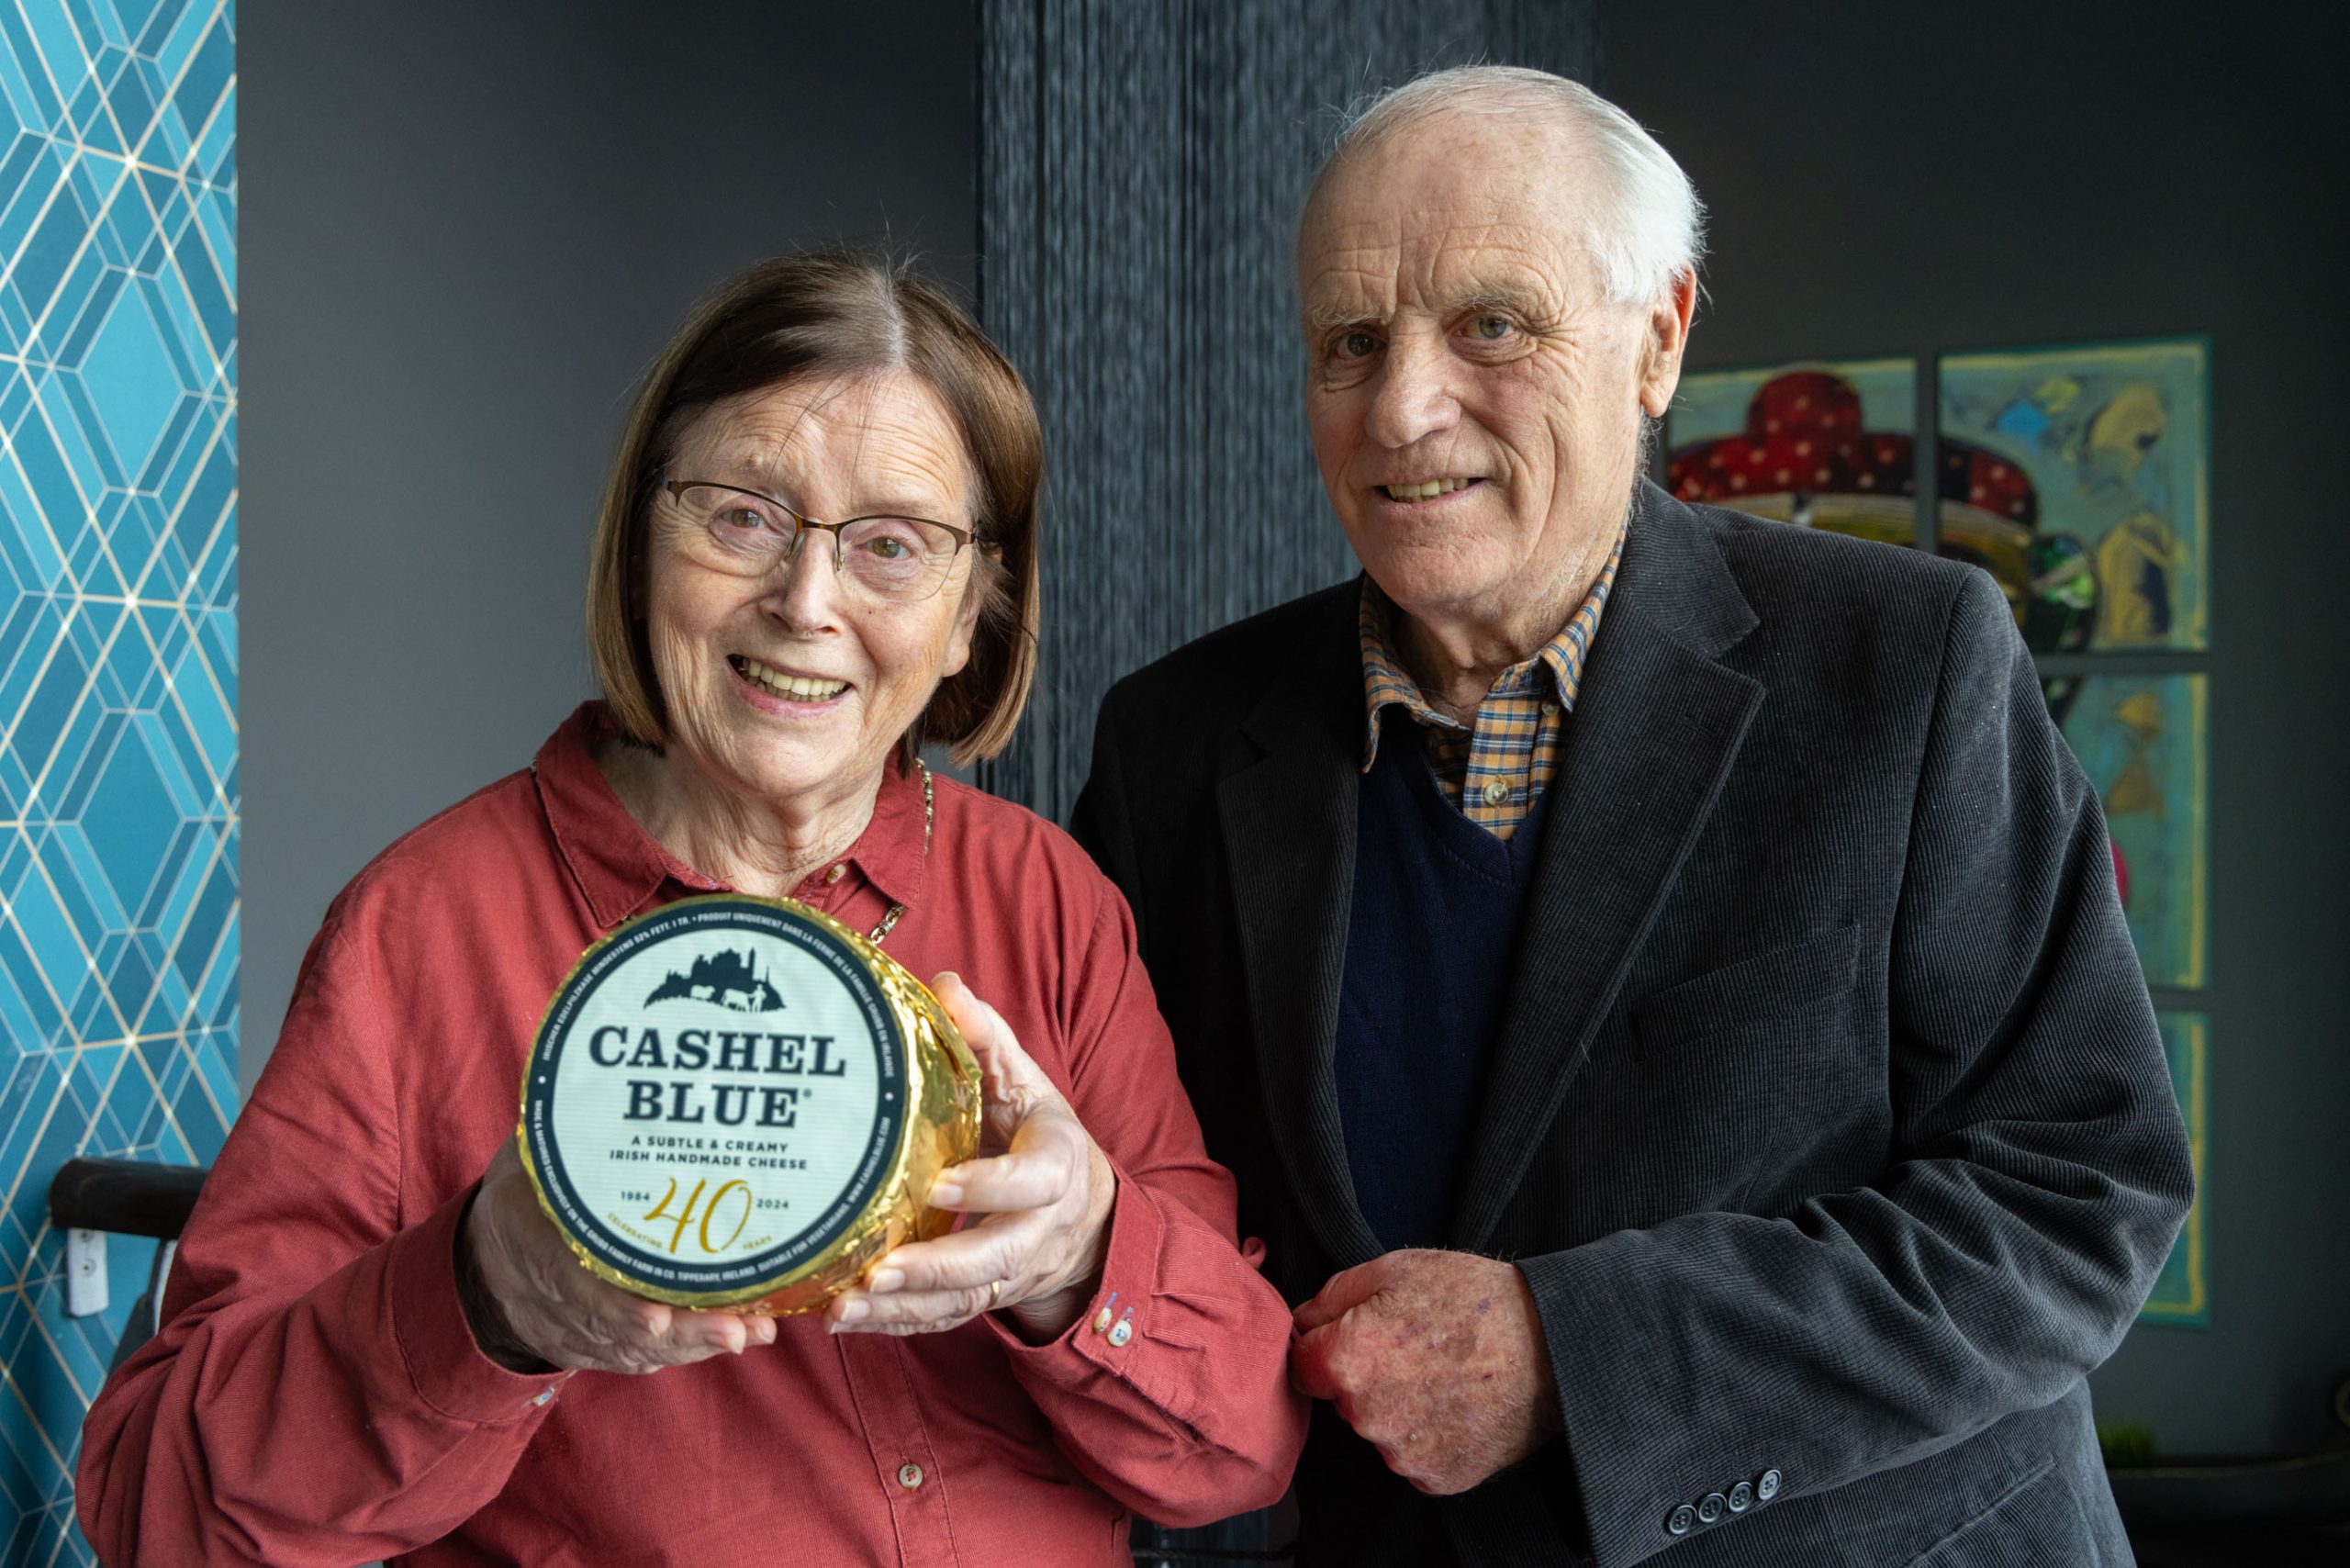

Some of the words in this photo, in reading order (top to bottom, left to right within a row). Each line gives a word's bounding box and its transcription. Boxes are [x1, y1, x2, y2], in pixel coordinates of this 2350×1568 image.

[781, 923, 803, 938] DANS
[801, 932, 813, 944] LA
[833, 955, 845, 968] DE
[841, 964, 853, 977] LA
[588, 1025, 846, 1077] CASHEL
[610, 1148, 651, 1161] IRISH
[655, 1150, 742, 1167] HANDMADE
[747, 1156, 808, 1170] CHEESE
[632, 1136, 642, 1147] A
[647, 1136, 704, 1149] SUBTLE
[711, 1139, 719, 1150] &
[725, 1139, 789, 1154] CREAMY
[533, 1122, 543, 1130] &
[566, 1207, 578, 1221] ON
[576, 1217, 589, 1233] THE
[607, 1246, 633, 1264] FAMILY
[632, 1259, 655, 1274] FARM
[653, 1267, 664, 1277] IN
[621, 1191, 650, 1202] 1984
[643, 1177, 753, 1254] 40
[756, 1198, 789, 1209] 2024
[607, 1212, 663, 1249] CELEBRATING
[743, 1235, 773, 1249] YEARS
[757, 1249, 793, 1272] SUITABLE
[791, 1240, 809, 1255] FOR
